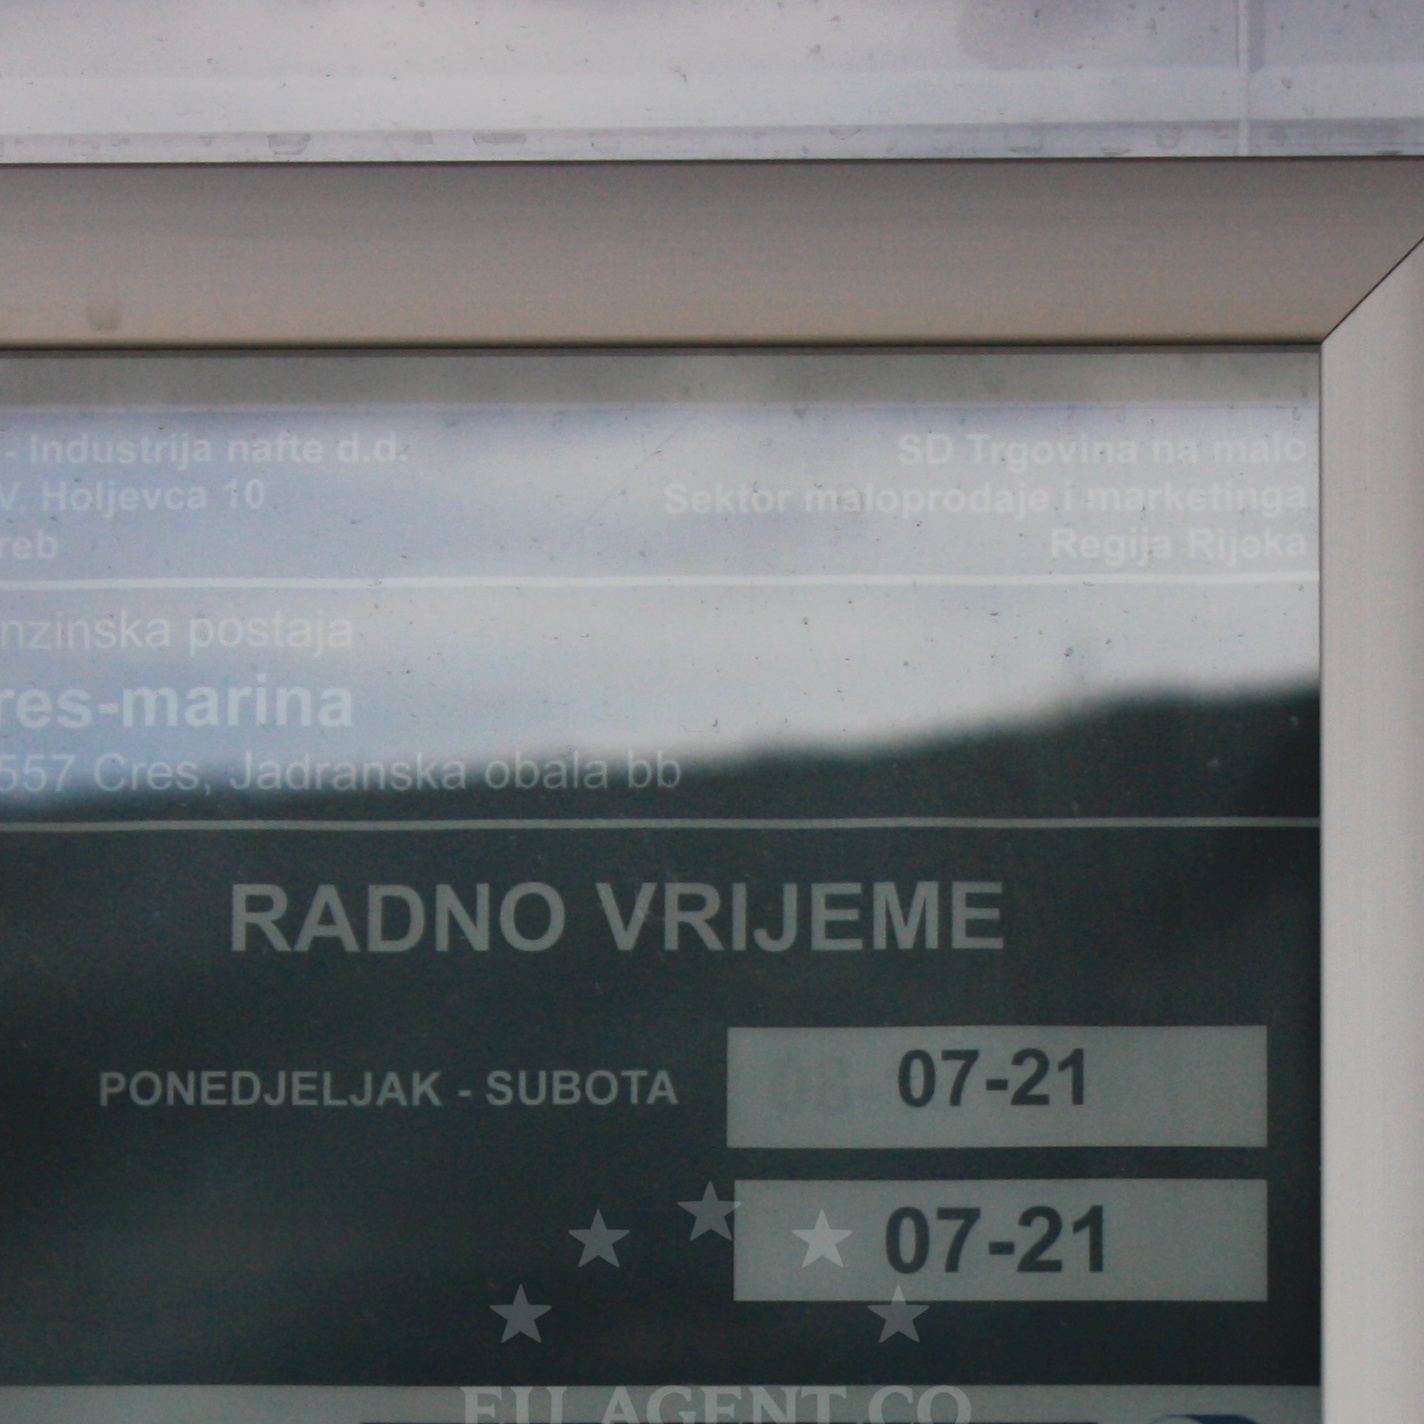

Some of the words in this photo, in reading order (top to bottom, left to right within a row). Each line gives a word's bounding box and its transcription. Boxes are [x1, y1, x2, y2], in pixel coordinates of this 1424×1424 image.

[29, 433, 212, 471] Industrija
[226, 433, 324, 464] nafte
[898, 433, 953, 466] SD
[967, 432, 1138, 472] Trgovina
[1153, 439, 1198, 464] na
[1213, 431, 1306, 462] malo
[40, 480, 207, 518] Holjevca
[224, 479, 265, 510] 10
[664, 482, 791, 515] Sektor
[805, 482, 1048, 520] maloprodaje
[1086, 480, 1306, 518] marketinga
[1051, 528, 1173, 567] Regija
[1188, 527, 1308, 565] Rijeka
[188, 610, 353, 659] postaja
[94, 753, 211, 797] Cres,
[229, 752, 467, 792] Jadranska
[484, 751, 608, 791] obala
[626, 751, 681, 790] bb
[230, 880, 566, 954] RADNO
[596, 880, 1004, 953] VRIJEME
[98, 1068, 443, 1109] PONEDJELJAK
[485, 1069, 679, 1108] SUBOTA
[897, 1047, 1089, 1109] 07-21
[885, 1205, 1107, 1276] 07-21
